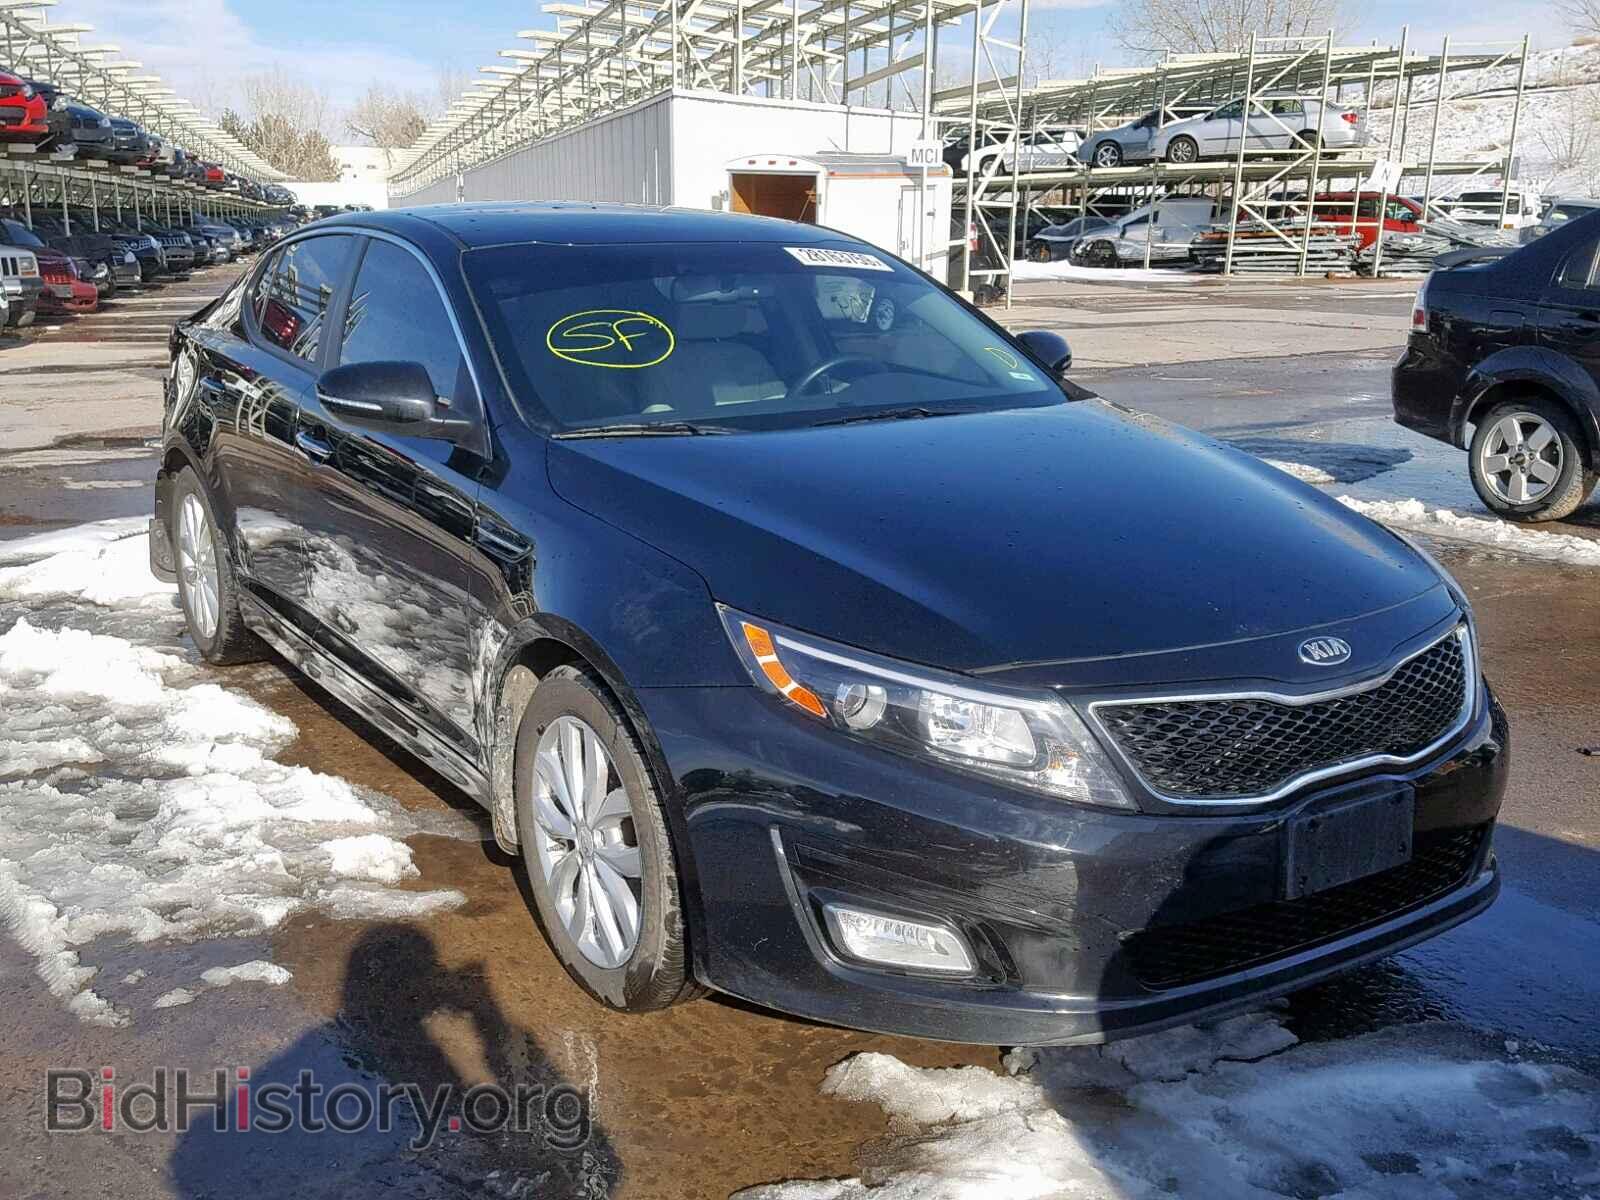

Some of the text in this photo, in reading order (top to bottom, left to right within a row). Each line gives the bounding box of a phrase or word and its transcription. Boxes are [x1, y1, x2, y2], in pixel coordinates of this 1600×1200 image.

[911, 148, 938, 163] MCI
[552, 317, 656, 352] SF
[1303, 639, 1348, 661] KIA
